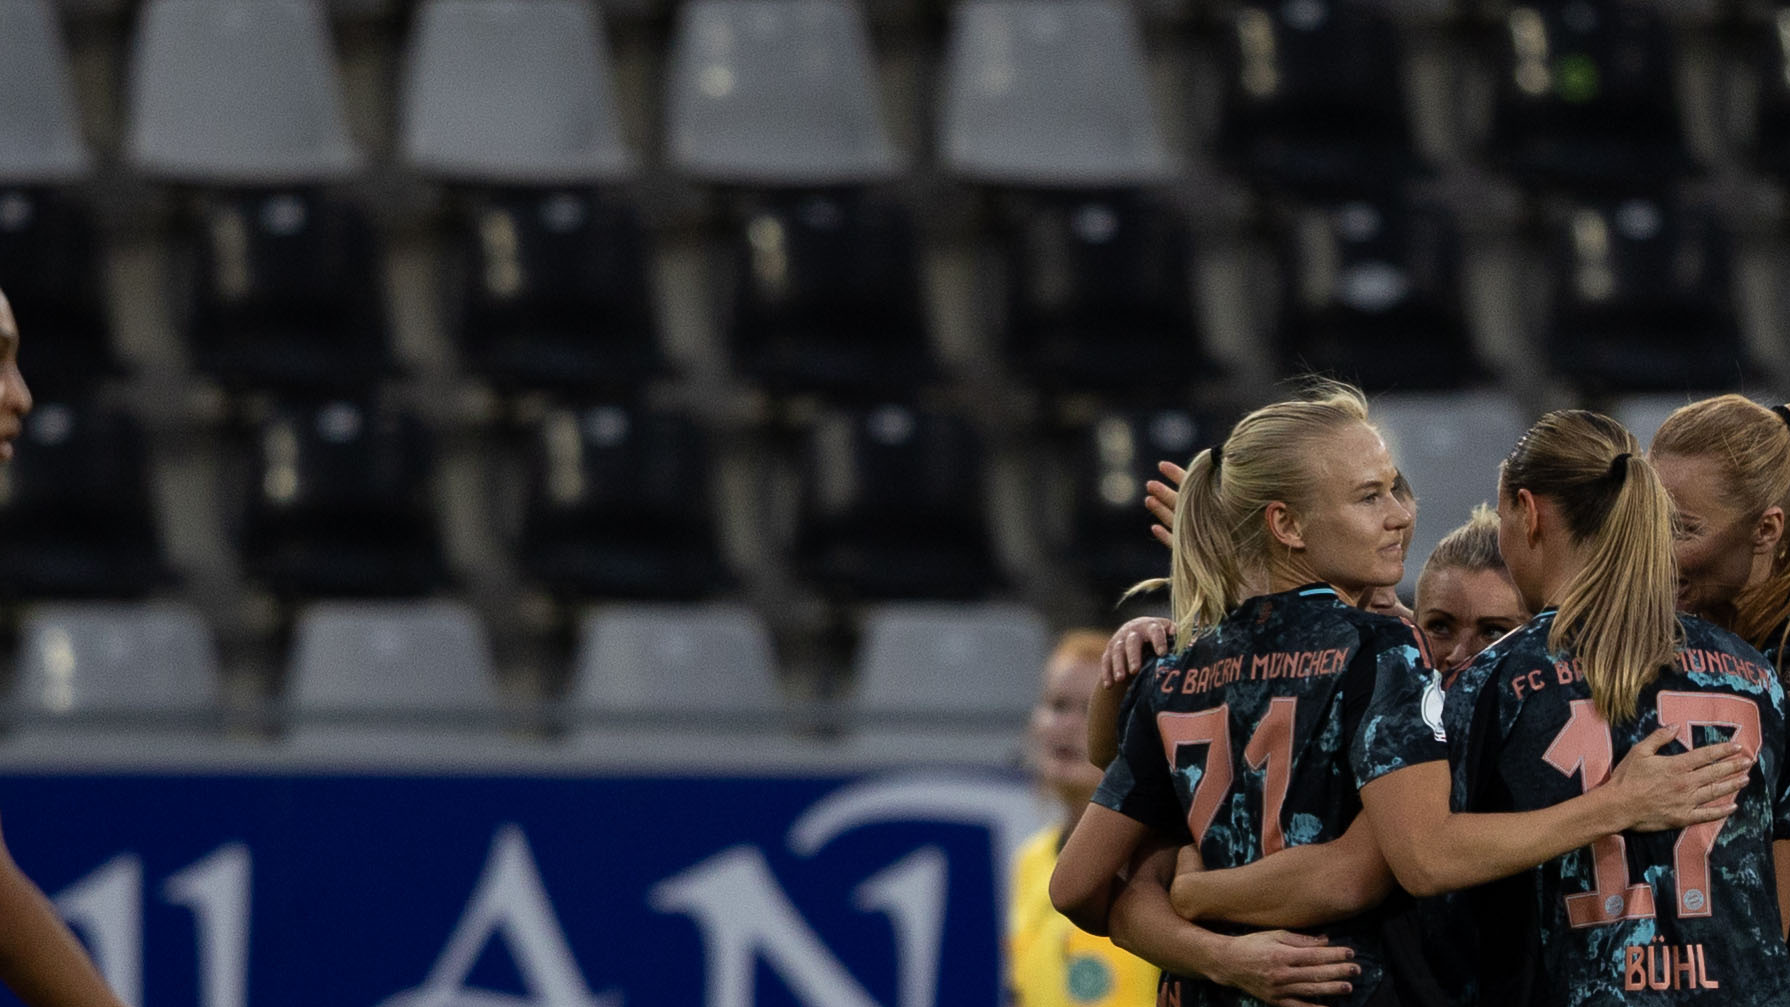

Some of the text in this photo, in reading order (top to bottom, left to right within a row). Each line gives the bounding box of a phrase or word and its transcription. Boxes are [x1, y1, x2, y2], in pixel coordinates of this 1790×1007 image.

[1182, 654, 1245, 695] BAYERN
[1250, 647, 1351, 681] MÜNCHEN
[1511, 669, 1546, 700] FC
[1157, 695, 1299, 858] 71
[1542, 690, 1763, 928] 17
[1625, 935, 1720, 991] BÜHL
